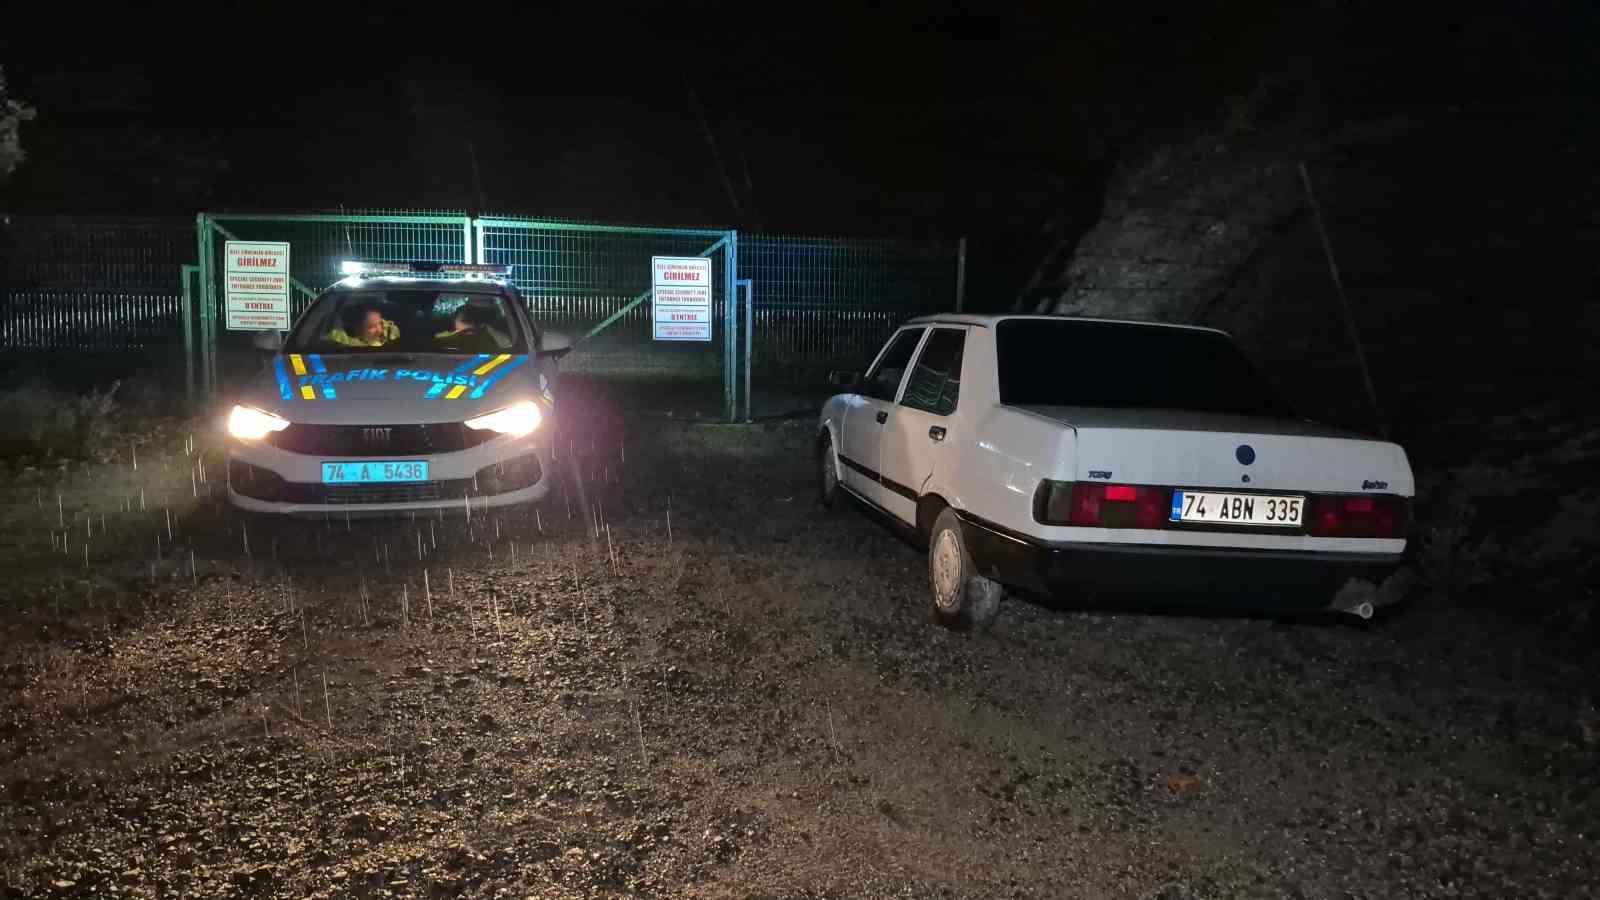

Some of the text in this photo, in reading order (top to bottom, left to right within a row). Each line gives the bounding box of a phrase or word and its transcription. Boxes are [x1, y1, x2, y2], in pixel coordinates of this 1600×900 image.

[327, 463, 423, 481] 74 A 5436
[1184, 495, 1300, 522] 74 ABN 335
